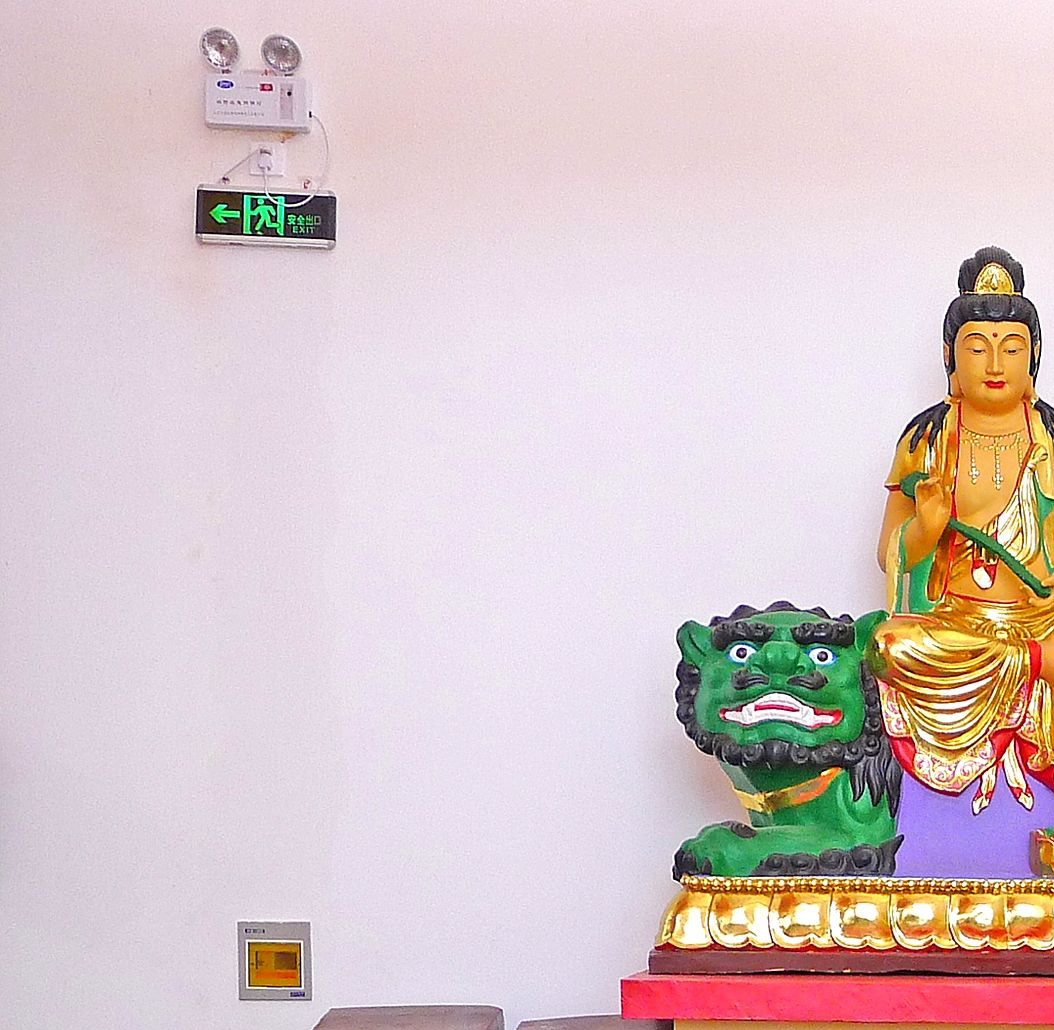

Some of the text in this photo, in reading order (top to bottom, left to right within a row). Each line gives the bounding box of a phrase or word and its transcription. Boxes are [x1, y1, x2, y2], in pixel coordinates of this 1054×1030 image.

[287, 214, 321, 225] 安全出口
[293, 225, 315, 234] EXIT
